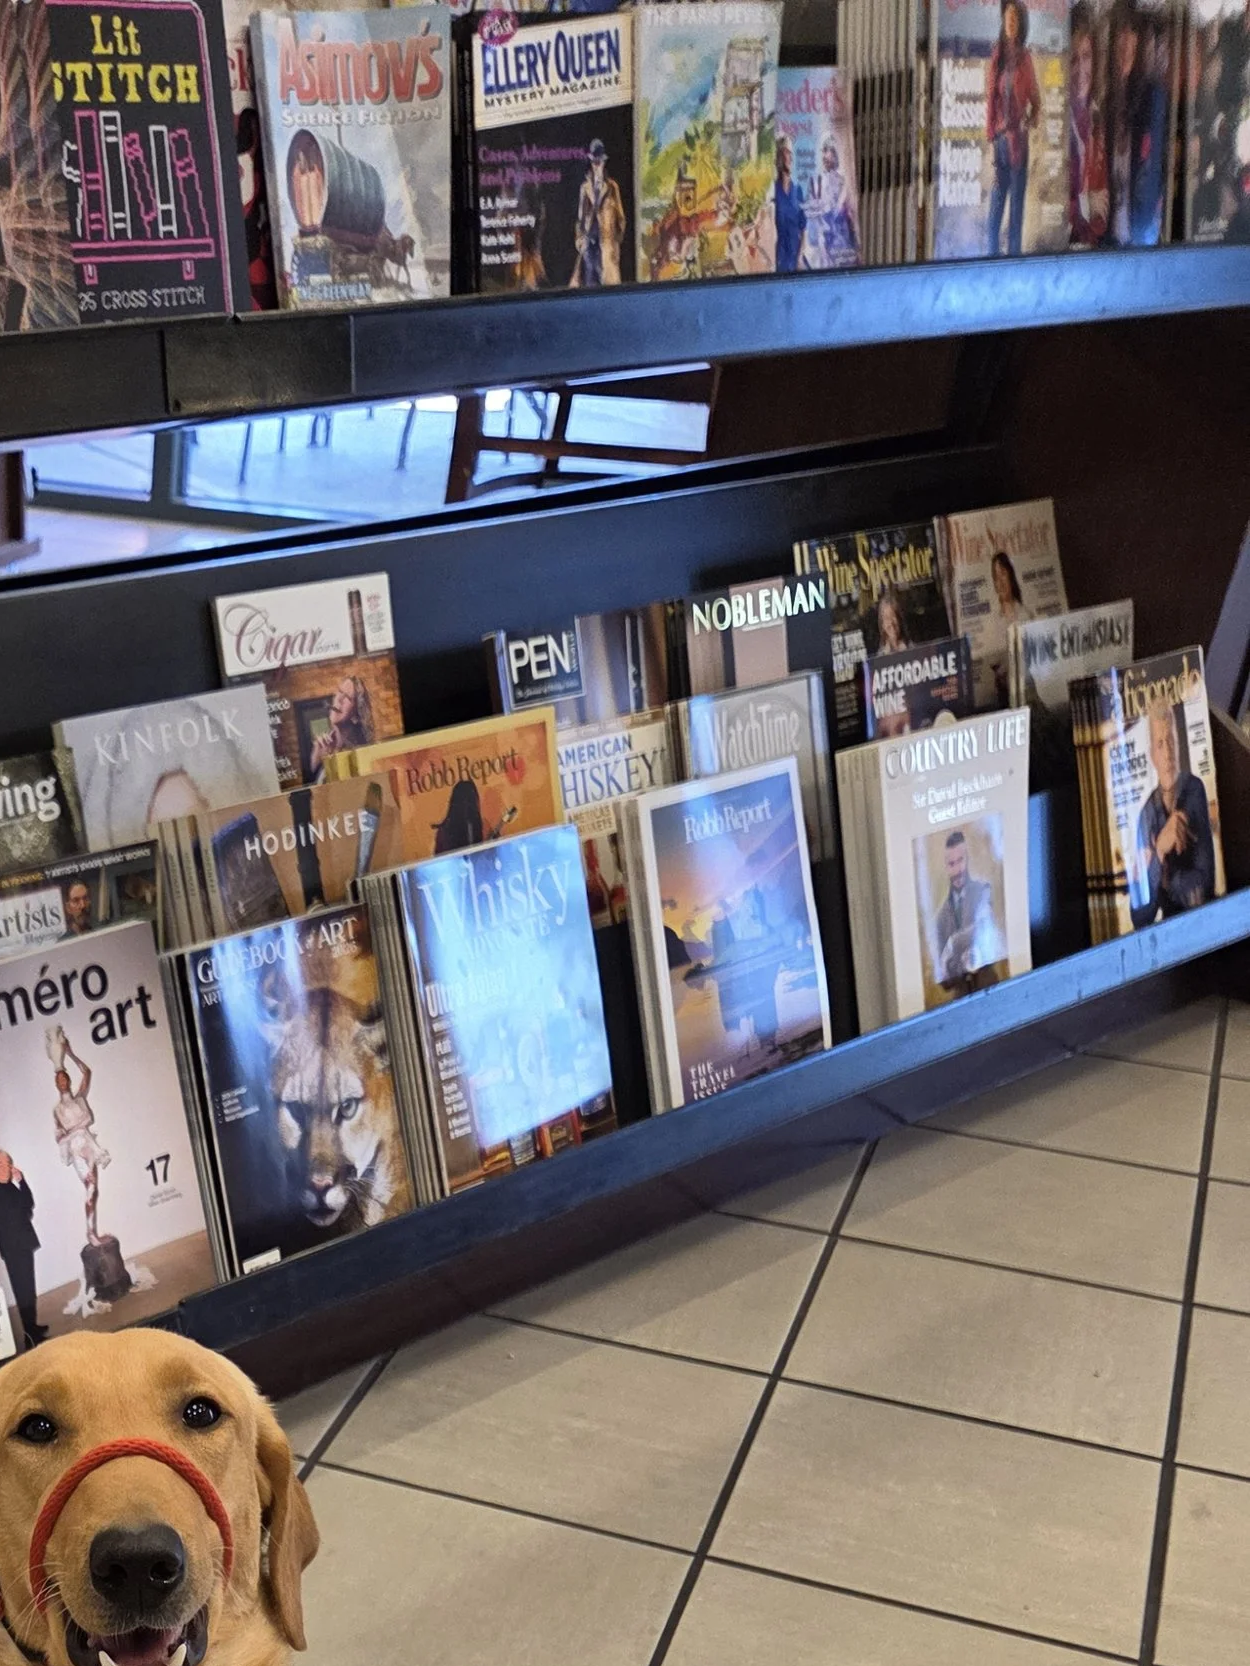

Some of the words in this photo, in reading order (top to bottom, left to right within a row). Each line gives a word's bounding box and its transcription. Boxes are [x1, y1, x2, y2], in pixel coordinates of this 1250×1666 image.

[91, 14, 142, 56] Lit
[481, 40, 552, 96] ELLERY
[554, 27, 622, 83] QUEEN
[484, 89, 547, 109] MYSTERY
[549, 76, 623, 97] MAGAZINE
[855, 530, 934, 602] Spectator
[692, 577, 827, 636] NOBLEMAN
[223, 601, 324, 679] Cigar
[508, 631, 572, 685] PEN
[1060, 614, 1132, 659] ENTHUSIAST
[872, 651, 958, 696] AFFORDABLE
[872, 688, 907, 720] WINE
[93, 708, 246, 768] KINFOLK
[557, 733, 633, 768] AMERICAN
[714, 701, 801, 772] WatchTime
[886, 727, 979, 779] COUNTRY
[987, 713, 1028, 753] LIFE
[406, 756, 456, 797] Robb
[454, 746, 519, 788] Report
[561, 746, 663, 809] HISKEY
[244, 809, 376, 862] HODINKEE
[684, 808, 724, 845] Robb
[722, 797, 773, 837] Report
[418, 843, 572, 948] Whisky
[317, 916, 359, 950] ART
[464, 916, 551, 962] ADVOCATE
[88, 985, 158, 1047] art
[689, 1060, 716, 1081] THE
[145, 1153, 170, 1186] 17
